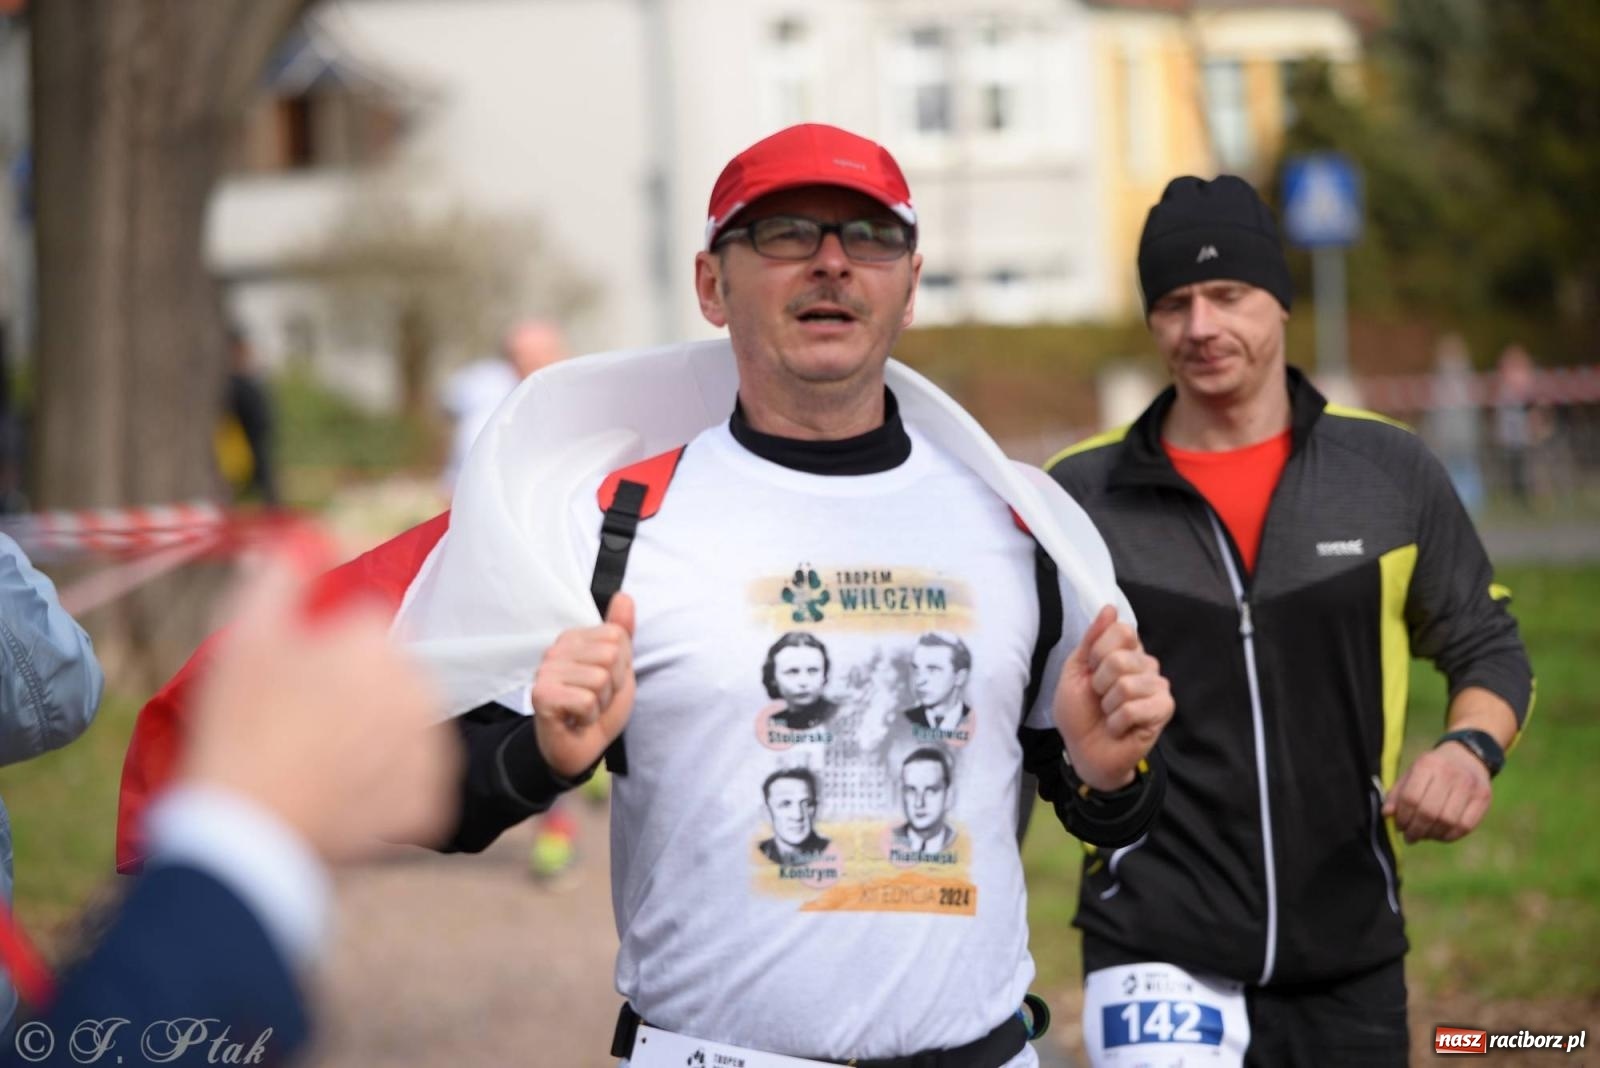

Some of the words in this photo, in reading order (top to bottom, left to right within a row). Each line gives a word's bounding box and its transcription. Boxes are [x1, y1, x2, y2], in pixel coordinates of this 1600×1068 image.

[836, 570, 892, 585] TROPEM
[839, 587, 947, 610] WILCZYM
[779, 864, 838, 881] Kontrym
[938, 887, 970, 906] 2024
[1120, 1001, 1202, 1043] 142
